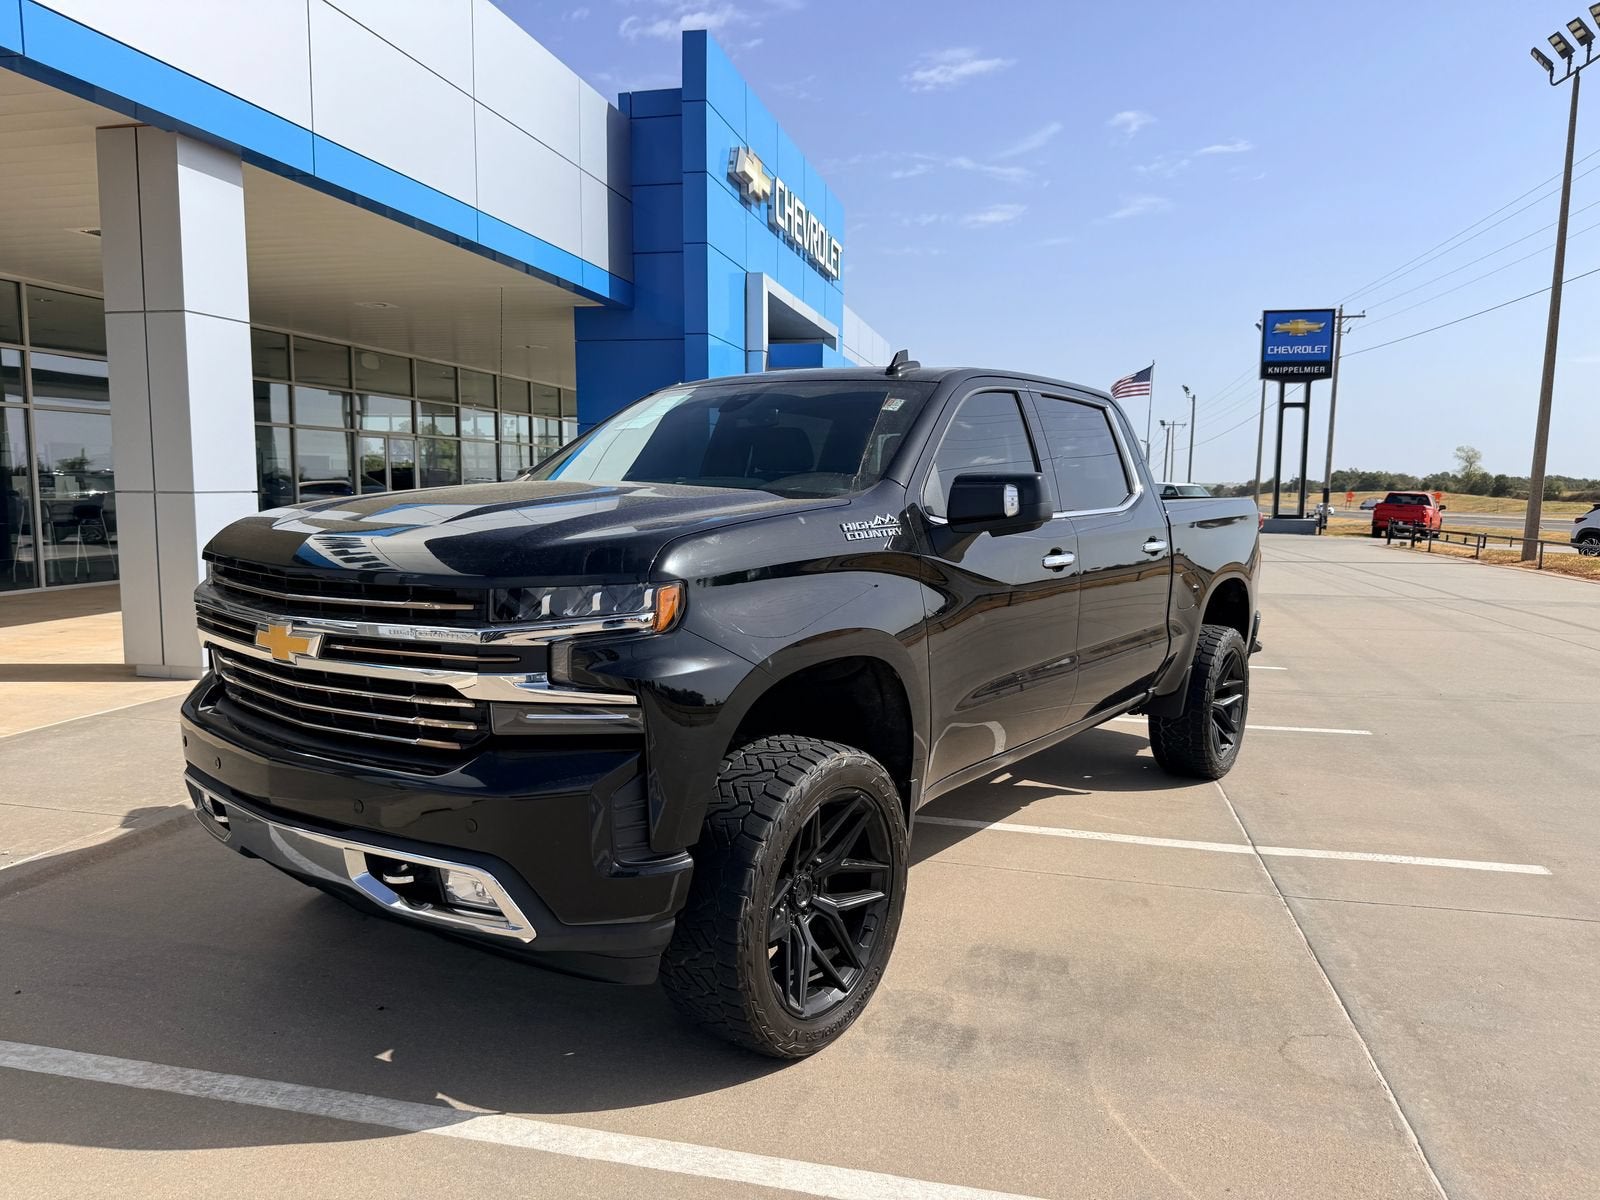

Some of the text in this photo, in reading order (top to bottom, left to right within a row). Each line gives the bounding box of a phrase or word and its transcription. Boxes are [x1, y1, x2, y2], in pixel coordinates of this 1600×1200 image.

[772, 176, 843, 281] CHEVROLET
[1267, 345, 1328, 355] CHEVROLET
[1267, 365, 1326, 375] KNIPPELMIER
[841, 520, 873, 532] HIGH
[845, 527, 902, 541] COUNTRY
